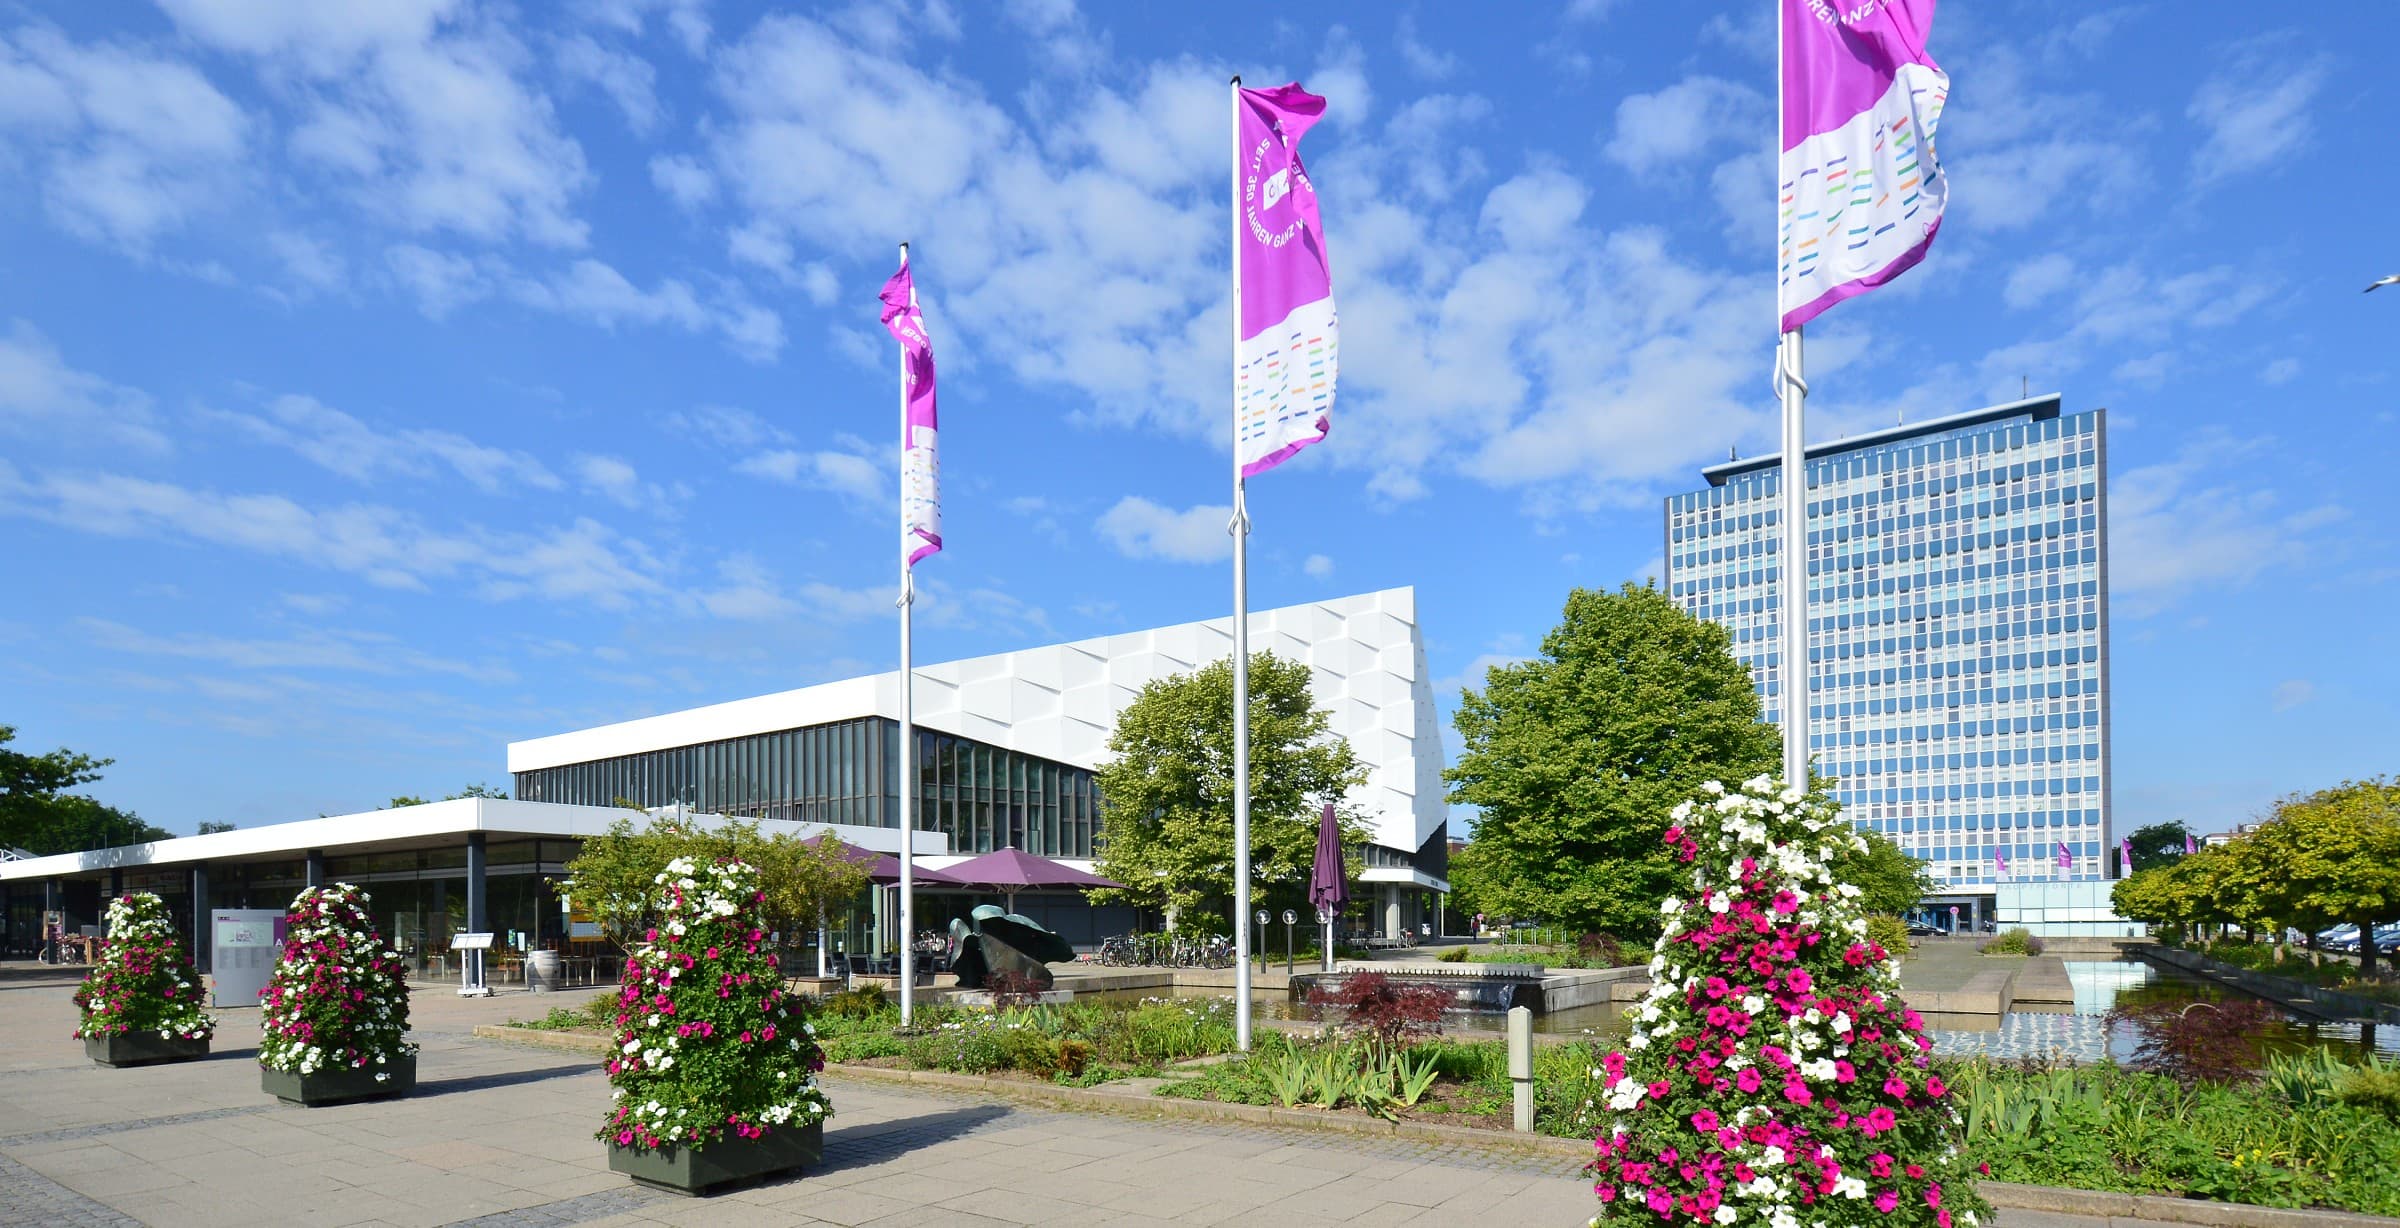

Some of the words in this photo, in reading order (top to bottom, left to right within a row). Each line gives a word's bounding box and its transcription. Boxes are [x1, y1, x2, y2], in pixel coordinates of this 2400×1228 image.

[1253, 138, 1270, 173] SEIT
[1246, 175, 1257, 202] 350
[1246, 205, 1273, 246] JAHREN
[1273, 223, 1295, 249] GANZ
